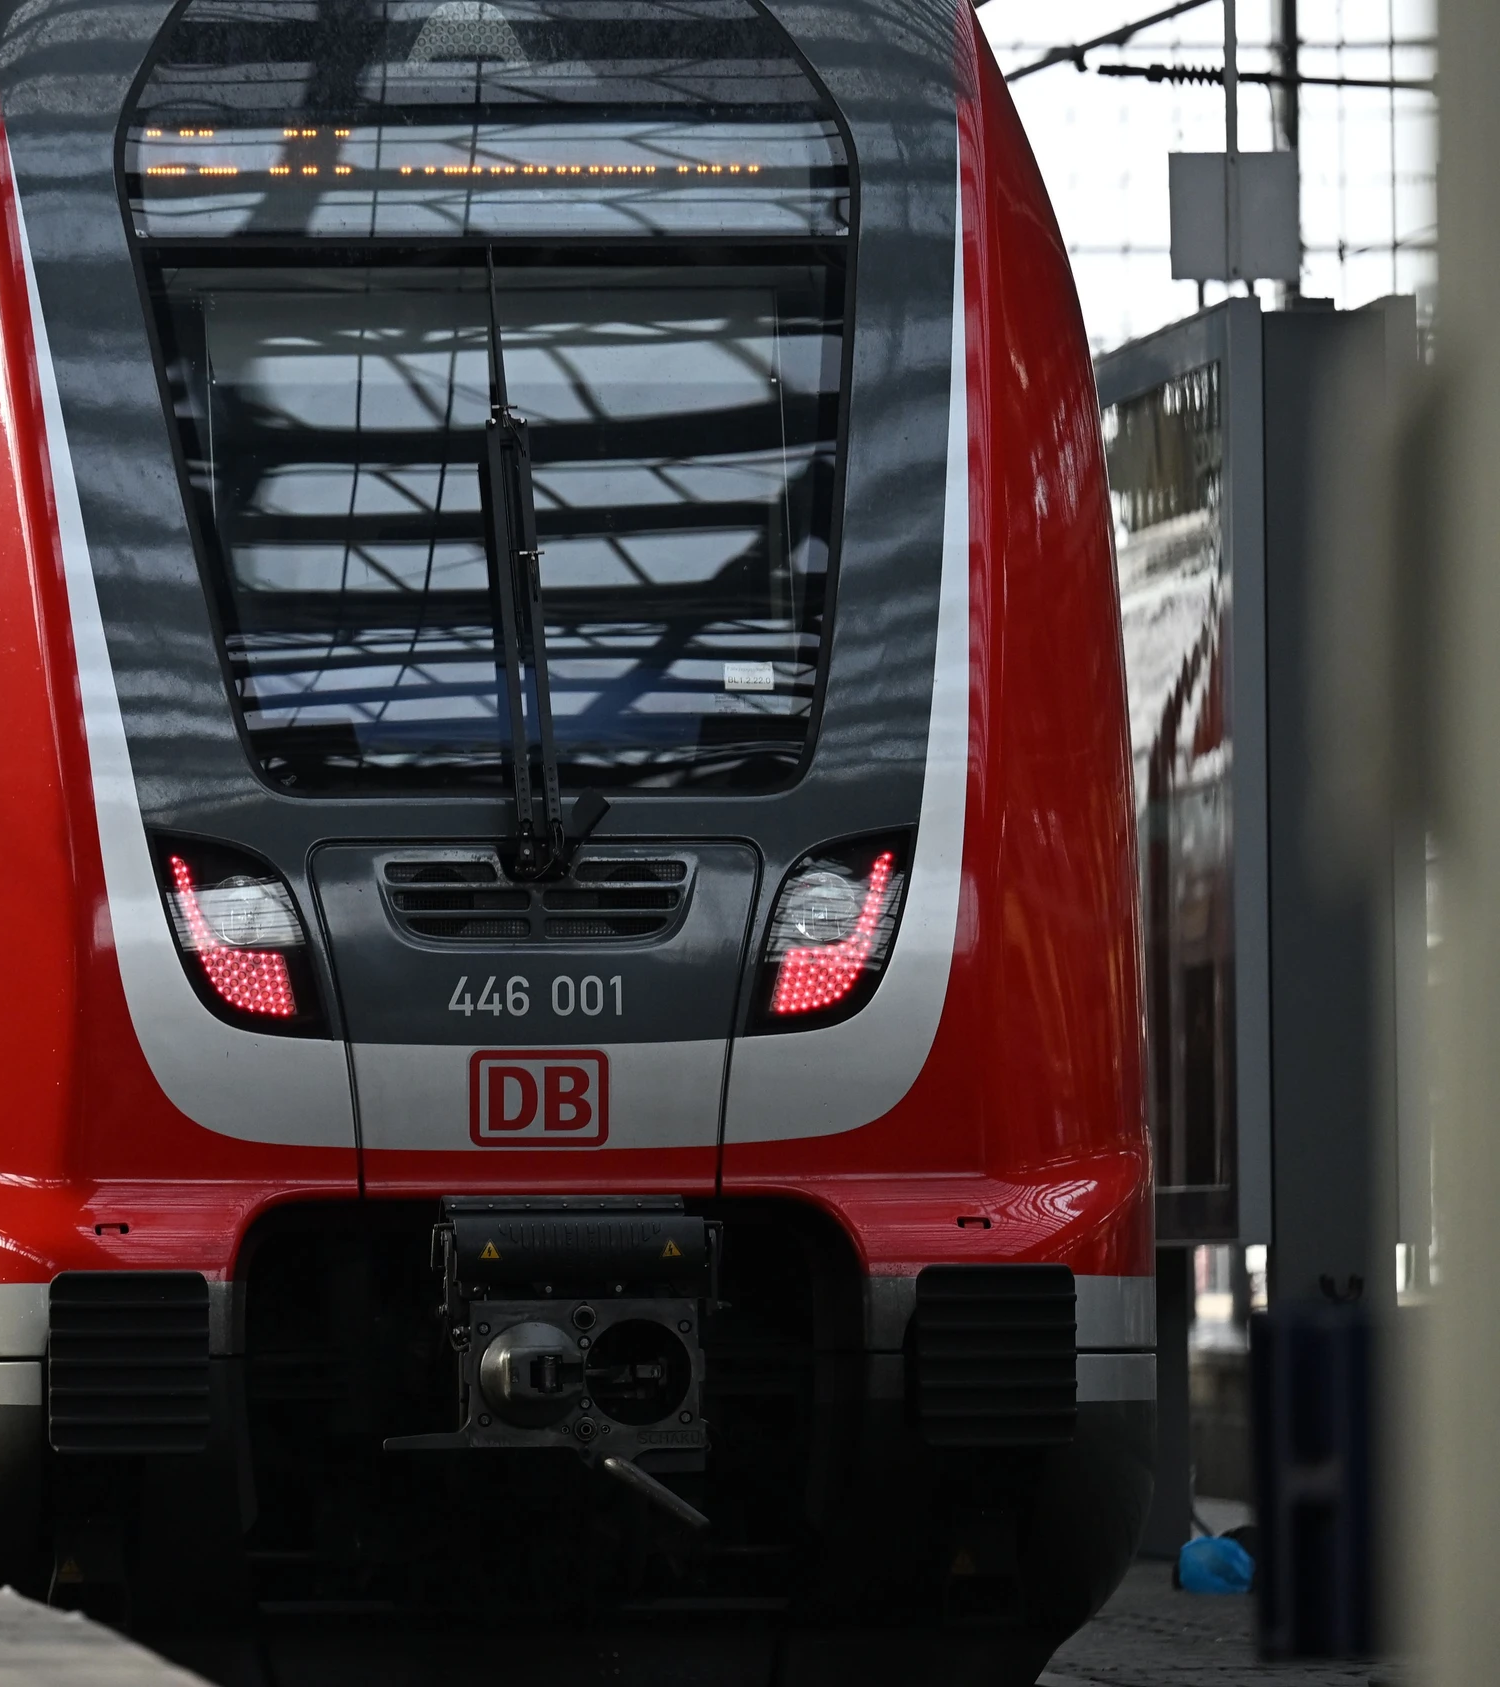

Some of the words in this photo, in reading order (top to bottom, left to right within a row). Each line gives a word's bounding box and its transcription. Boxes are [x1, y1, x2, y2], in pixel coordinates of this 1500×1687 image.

[448, 975, 530, 1017] 446
[551, 975, 623, 1016] 001
[488, 1066, 592, 1131] DB
[638, 1431, 699, 1445] SCHAKU
